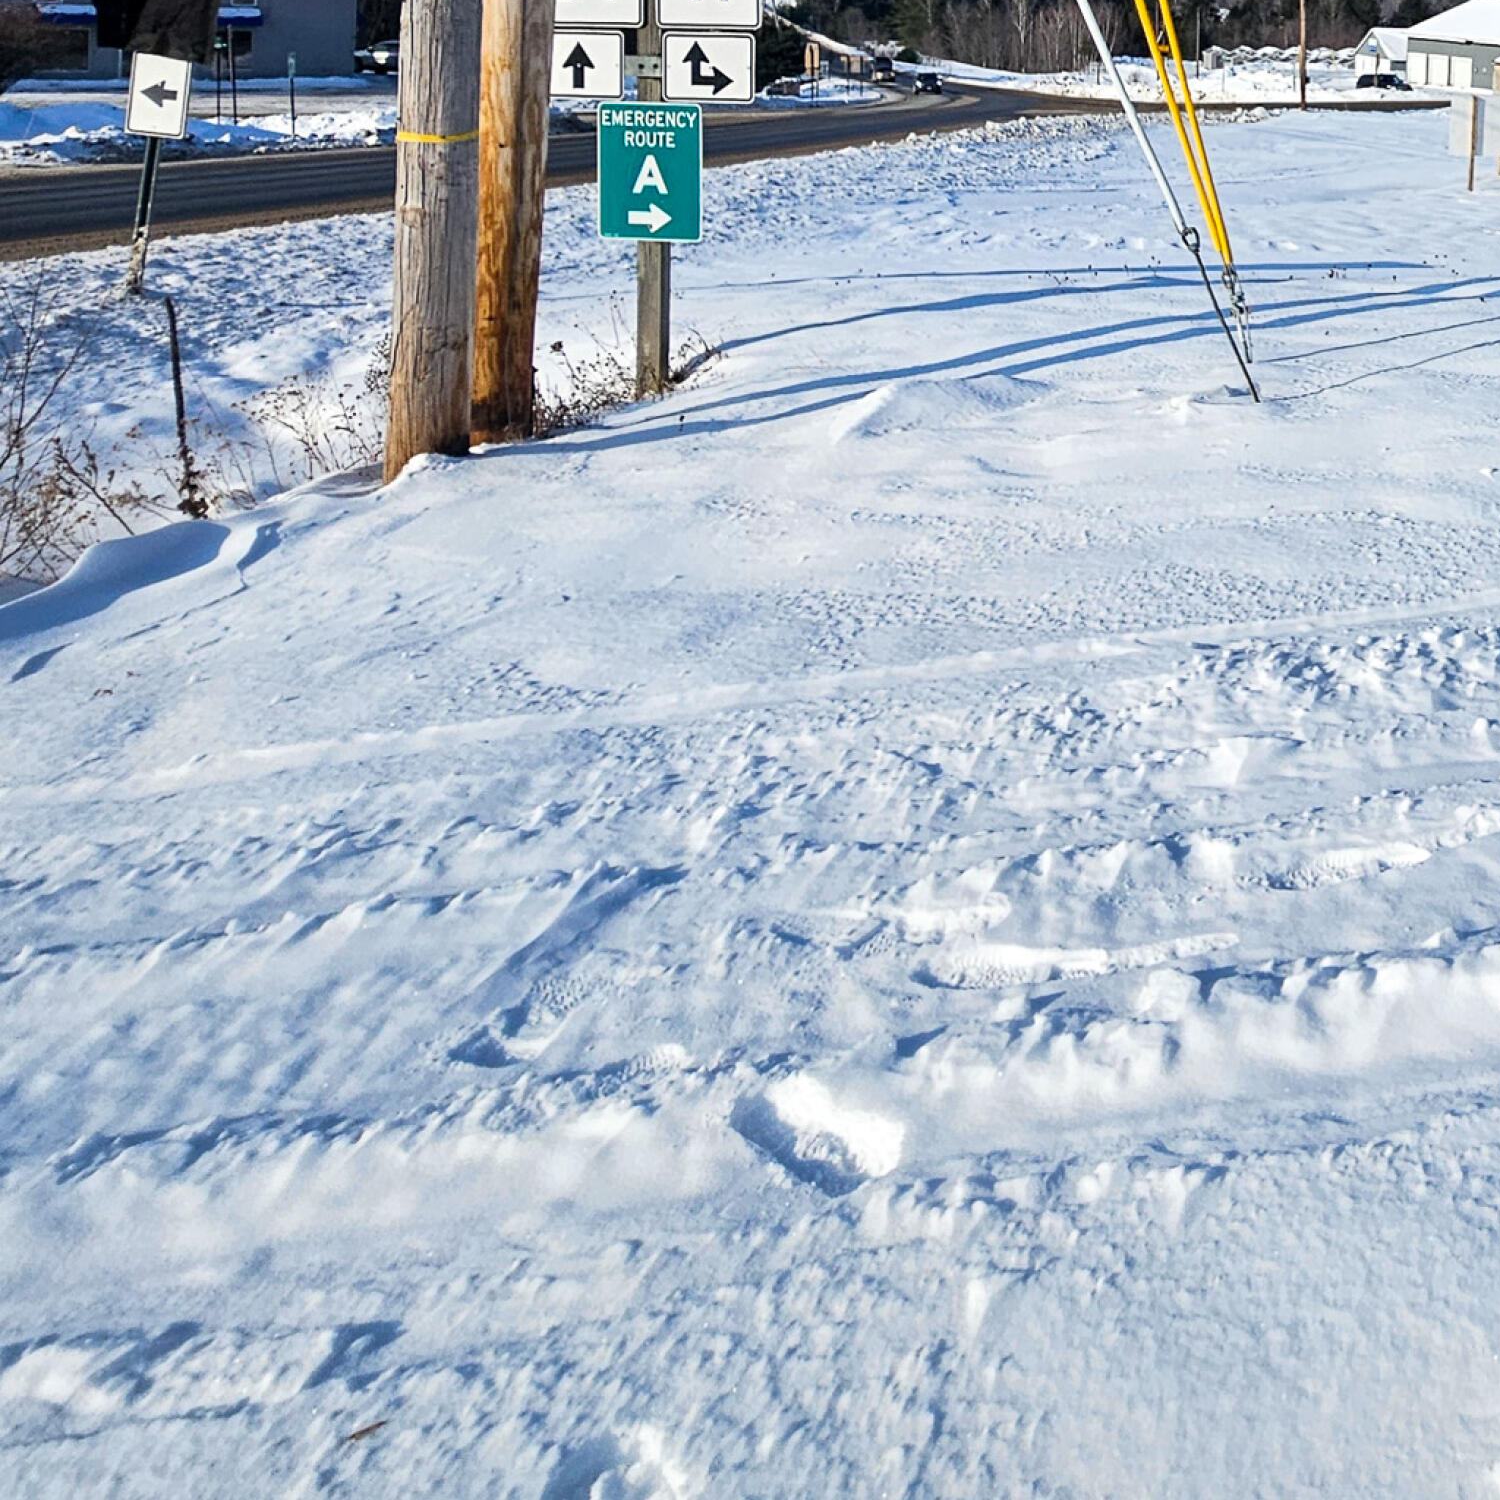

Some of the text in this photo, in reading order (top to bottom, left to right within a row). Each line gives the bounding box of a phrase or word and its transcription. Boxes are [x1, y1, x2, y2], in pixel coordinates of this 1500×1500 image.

[601, 109, 697, 128] EMERGENCY
[623, 130, 676, 148] ROUTE
[632, 154, 669, 195] A
